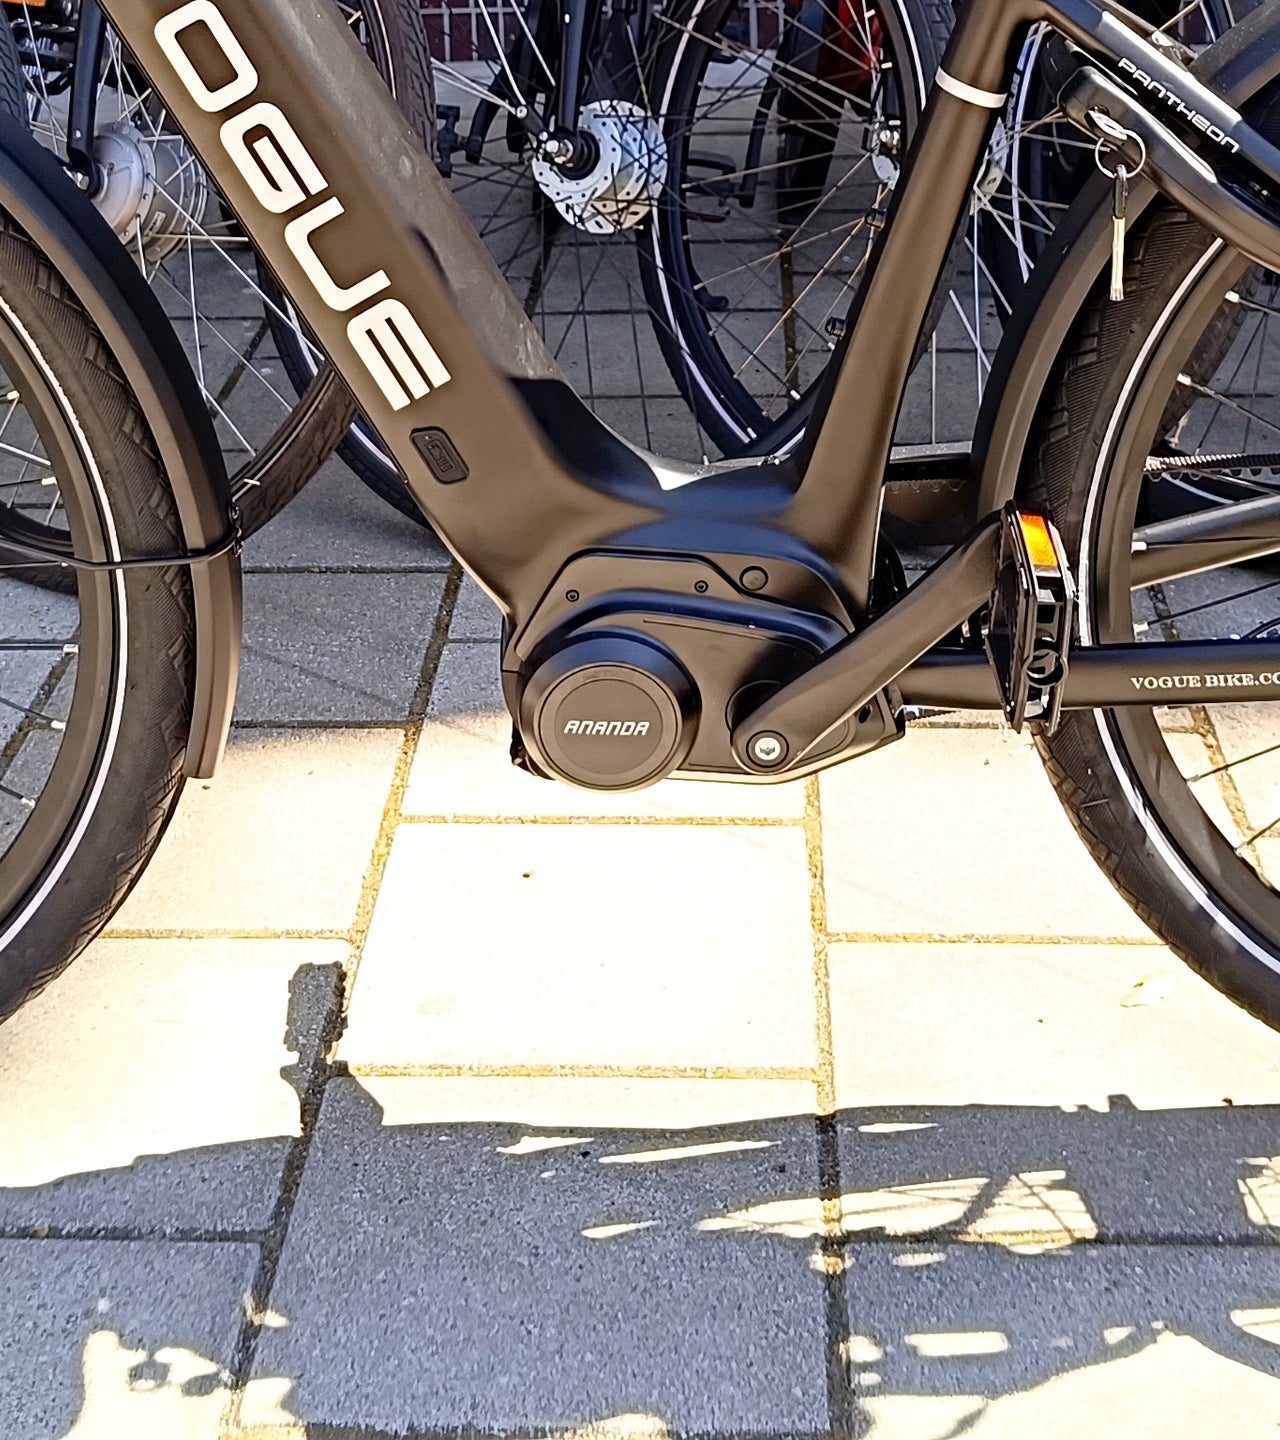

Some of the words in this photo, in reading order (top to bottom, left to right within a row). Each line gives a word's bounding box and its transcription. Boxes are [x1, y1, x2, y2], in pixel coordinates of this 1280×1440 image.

[1117, 57, 1240, 154] PANTHEON
[1130, 675, 1202, 690] VOGUE
[563, 720, 651, 736] ANANDA
